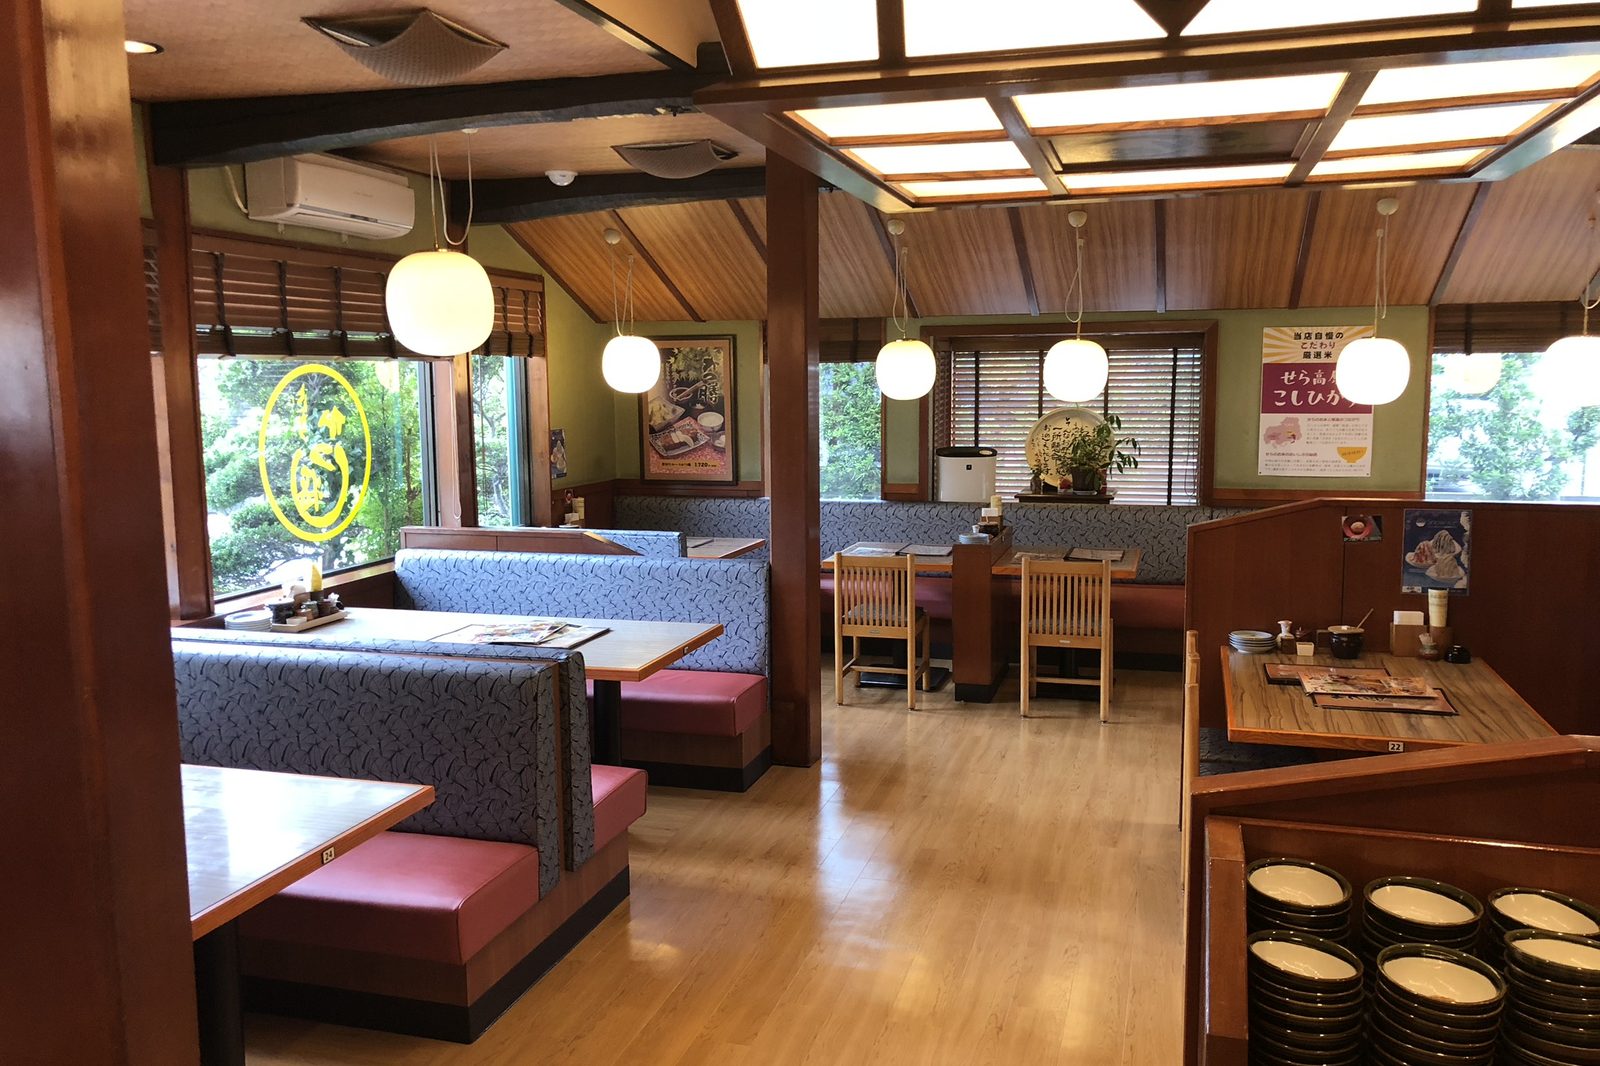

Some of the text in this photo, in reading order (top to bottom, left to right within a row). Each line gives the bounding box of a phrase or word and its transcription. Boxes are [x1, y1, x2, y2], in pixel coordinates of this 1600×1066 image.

[1293, 331, 1344, 341] 当店自慢の
[1300, 341, 1336, 350] こだわり
[1302, 351, 1333, 360] 厳選米
[1273, 389, 1356, 408] こしひか
[1390, 743, 1401, 751] 22
[324, 849, 333, 862] 24
